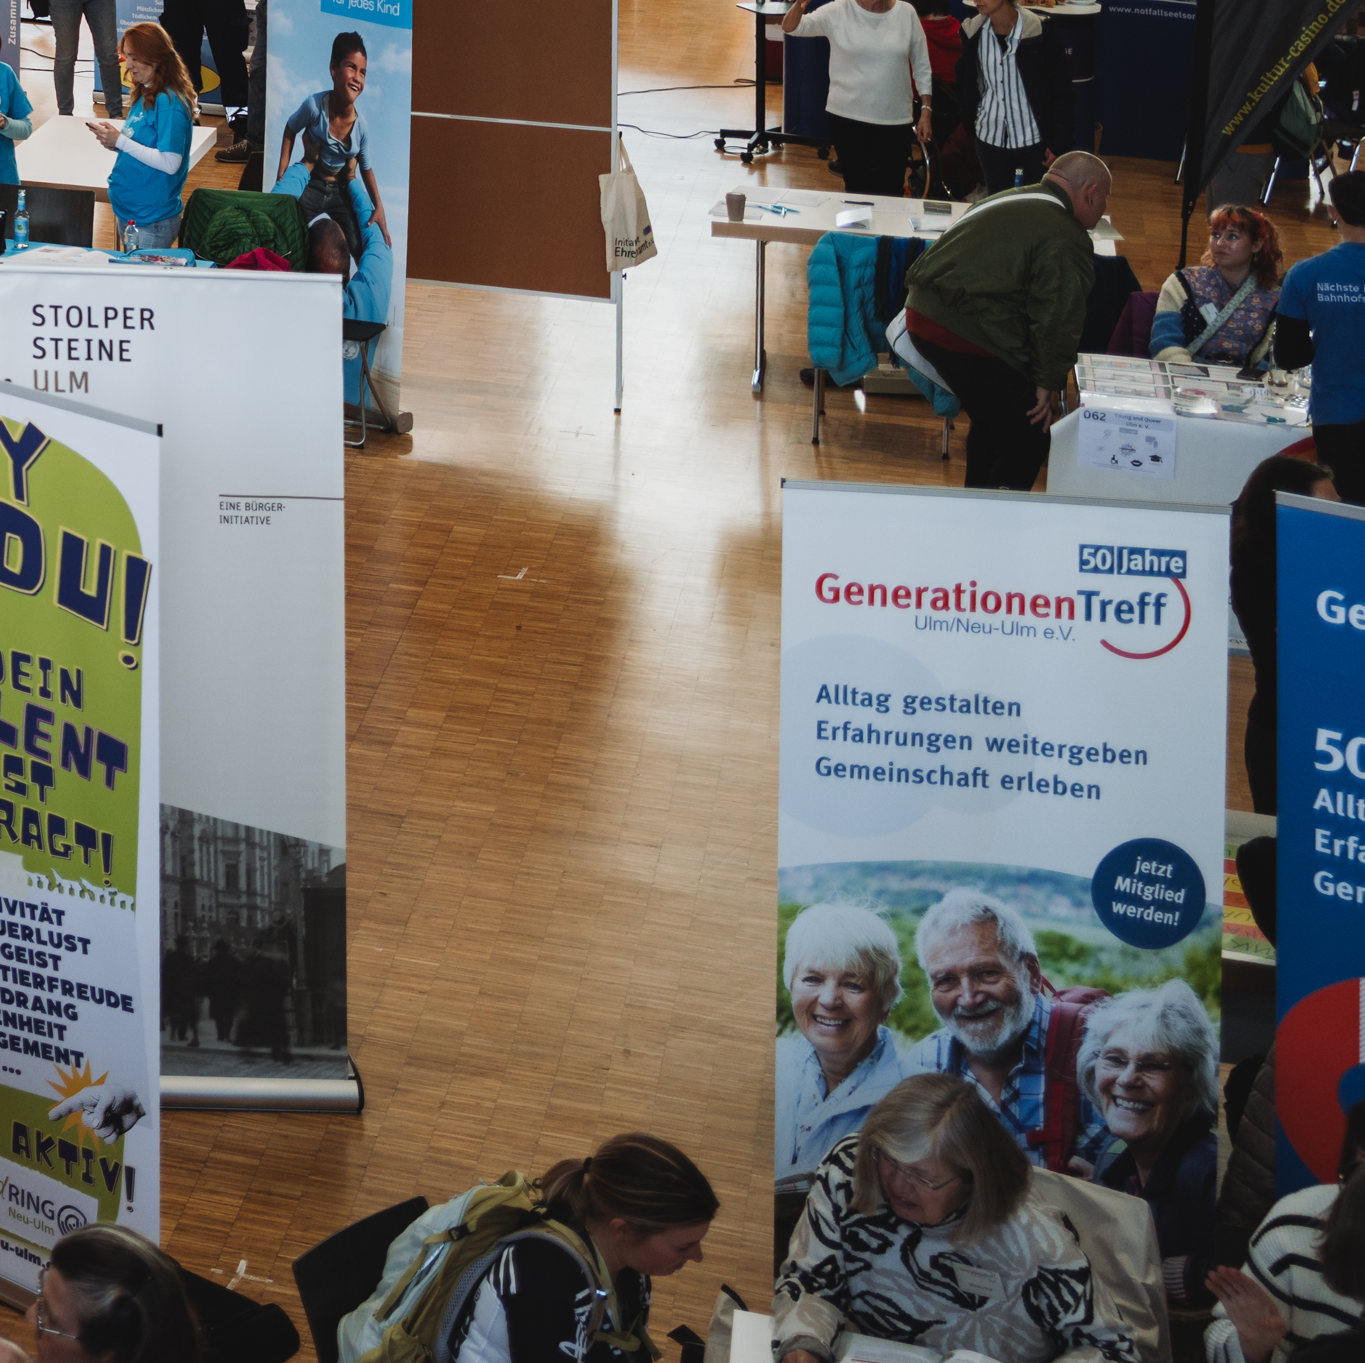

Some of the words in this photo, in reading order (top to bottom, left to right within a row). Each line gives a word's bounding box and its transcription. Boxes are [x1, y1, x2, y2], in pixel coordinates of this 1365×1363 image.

[1317, 282, 1359, 292] Nächste
[32, 304, 155, 330] STOLPER
[32, 337, 132, 362] STEINE
[33, 369, 89, 393] ULM
[1083, 410, 1106, 421] 062
[219, 502, 241, 510] EINE
[245, 501, 286, 511] BÜRGER-
[219, 515, 271, 525] INITIATIVE
[1081, 547, 1112, 569] 50
[1120, 550, 1184, 574] Jahre
[815, 572, 1168, 626] GenerationenTreff
[914, 615, 1037, 638] Ulm/Neu-Ulm
[1043, 625, 1076, 641] e.V.
[816, 684, 892, 713] Alltag
[903, 692, 1021, 717] gestalten
[816, 720, 973, 753] Erfahrungen
[985, 733, 1148, 766] weitergeben
[815, 756, 989, 789] Gemeinschaft
[1000, 771, 1101, 800] erleben
[1134, 856, 1173, 878] jetzt
[1114, 876, 1185, 904] Mitglied
[1112, 900, 1179, 926] werden!
[11, 1120, 136, 1213] AKTIV!
[9, 1207, 54, 1236] Neu-Ulm
